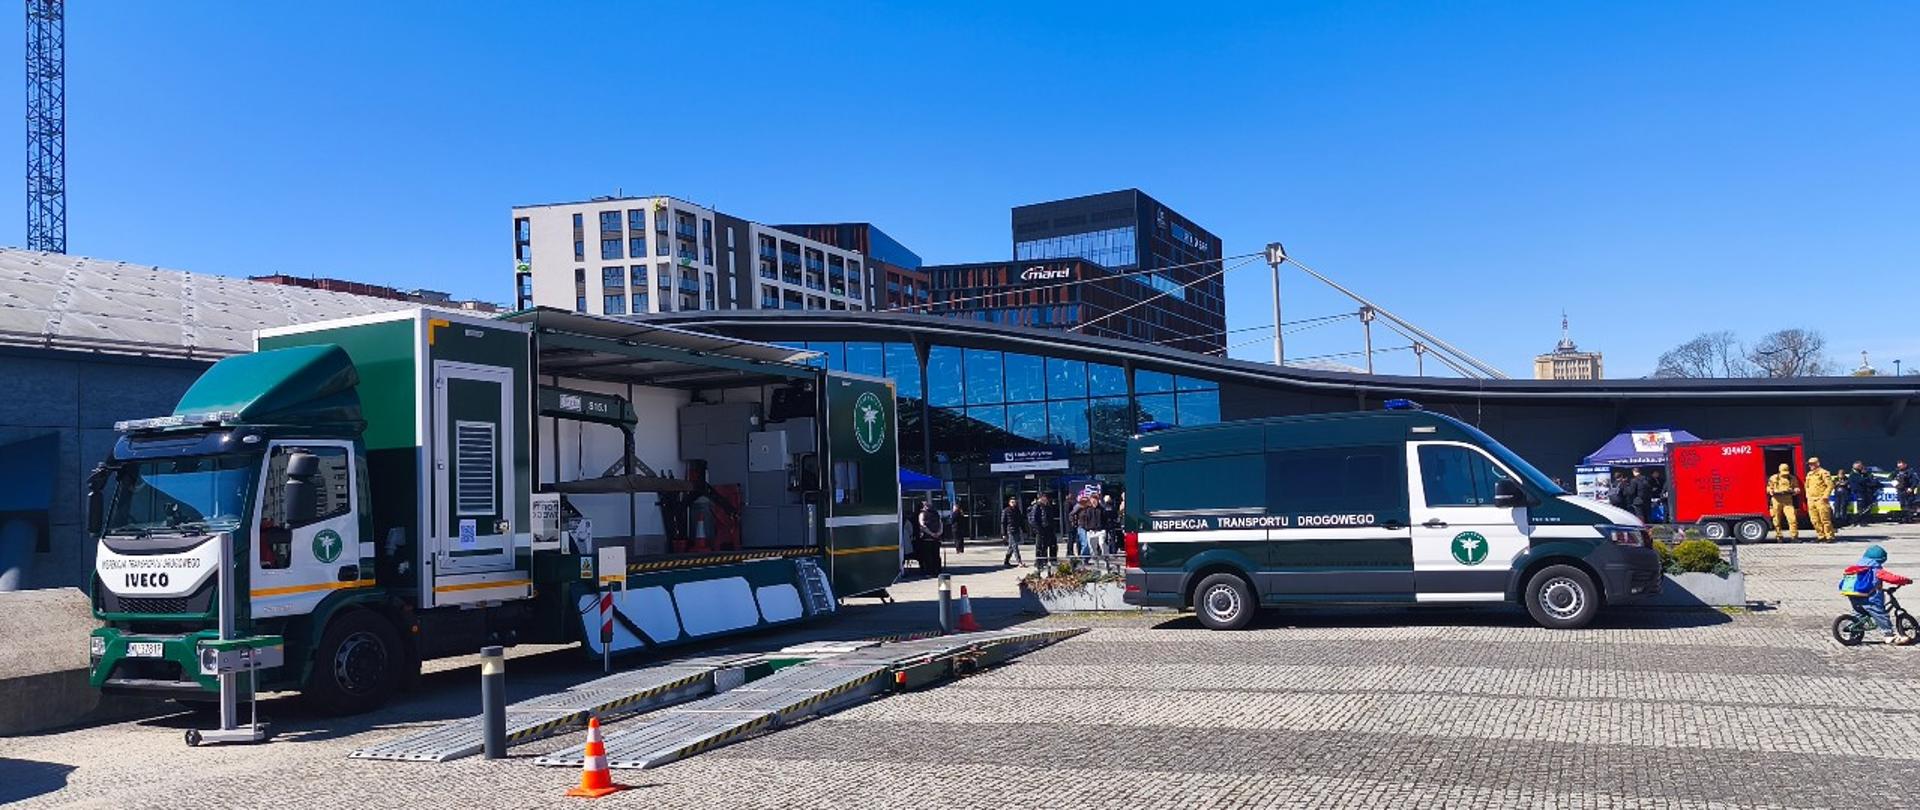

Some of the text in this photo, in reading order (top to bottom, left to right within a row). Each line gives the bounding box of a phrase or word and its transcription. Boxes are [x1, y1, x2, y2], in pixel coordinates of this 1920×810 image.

[1022, 266, 1069, 280] marel
[1152, 514, 1375, 531] INSPEKCJA TRANSPORTU DROGOWEGO
[126, 573, 168, 588] IVECO
